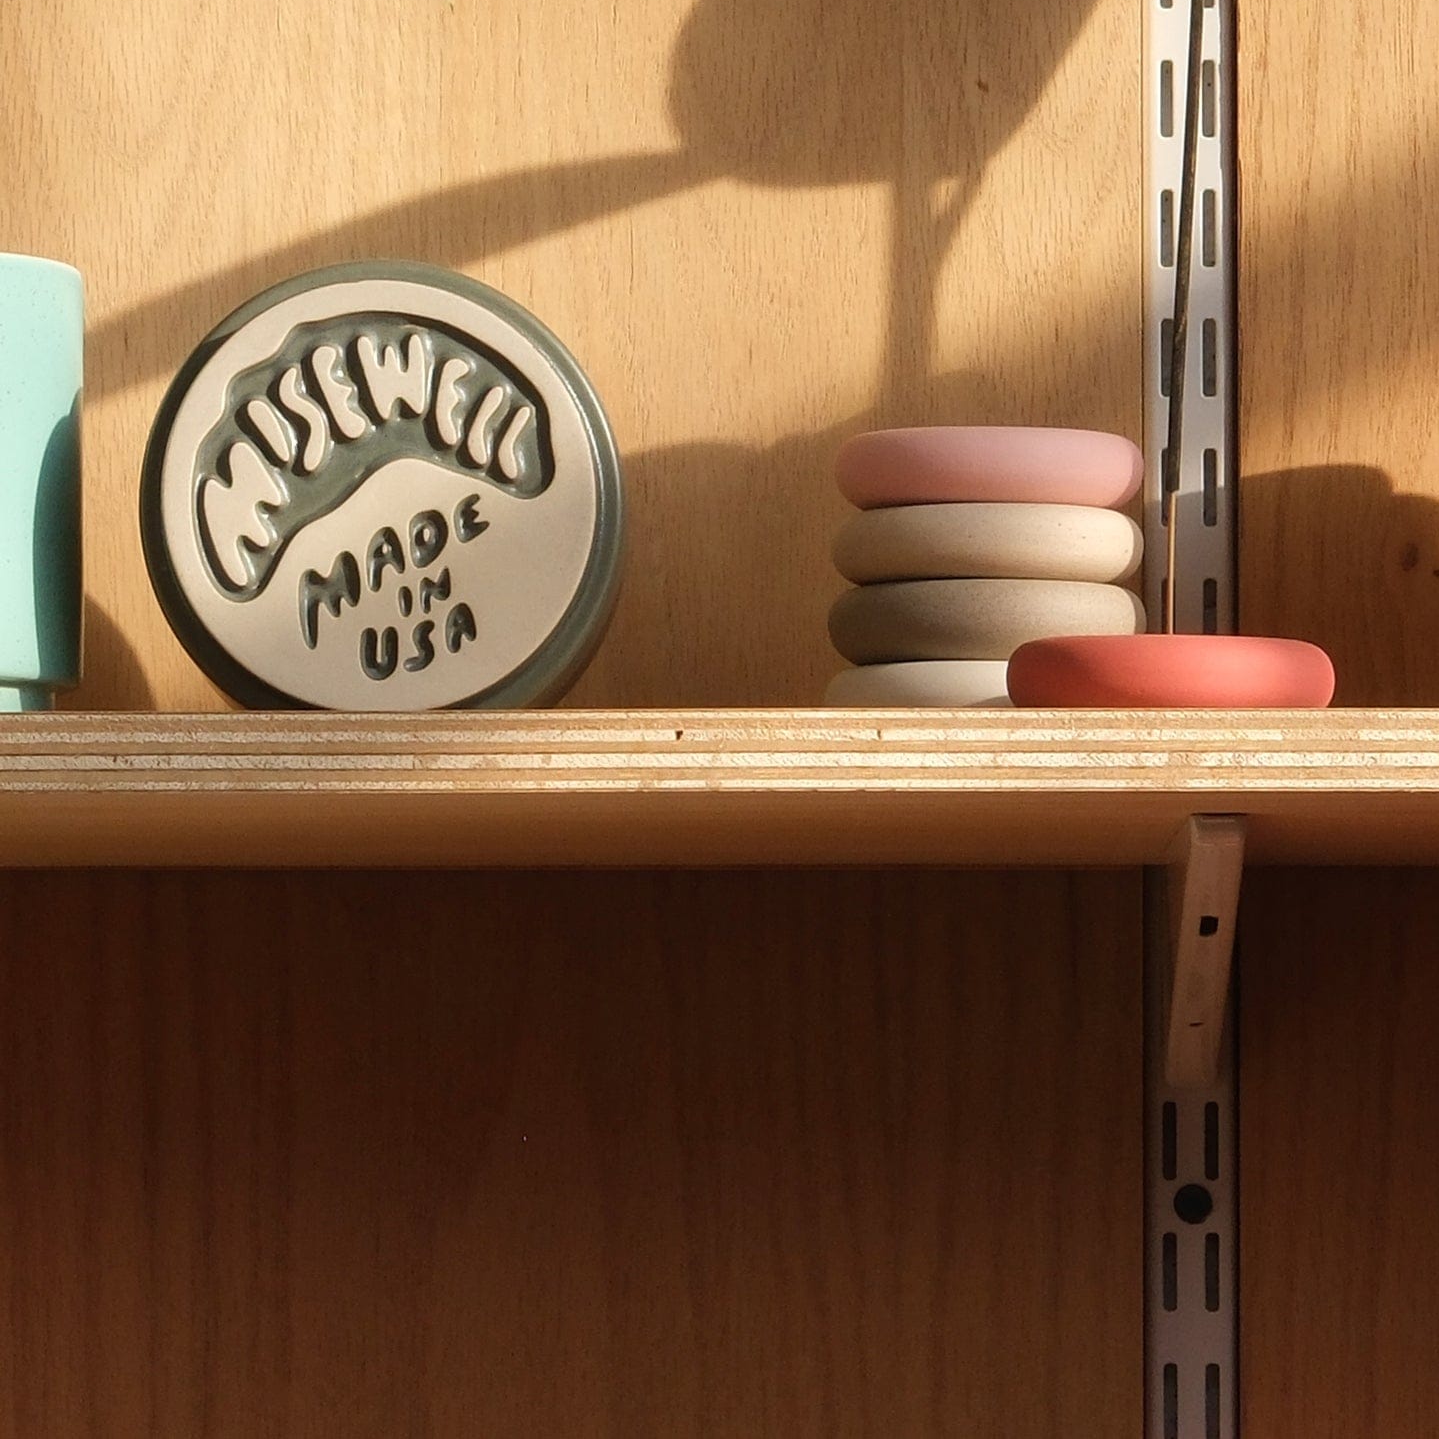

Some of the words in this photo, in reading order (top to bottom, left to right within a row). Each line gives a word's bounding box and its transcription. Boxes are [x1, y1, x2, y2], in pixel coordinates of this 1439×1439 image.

[203, 333, 532, 587] MISEWELL
[300, 493, 490, 650] MADE
[399, 567, 451, 617] IN
[359, 602, 477, 680] USA
